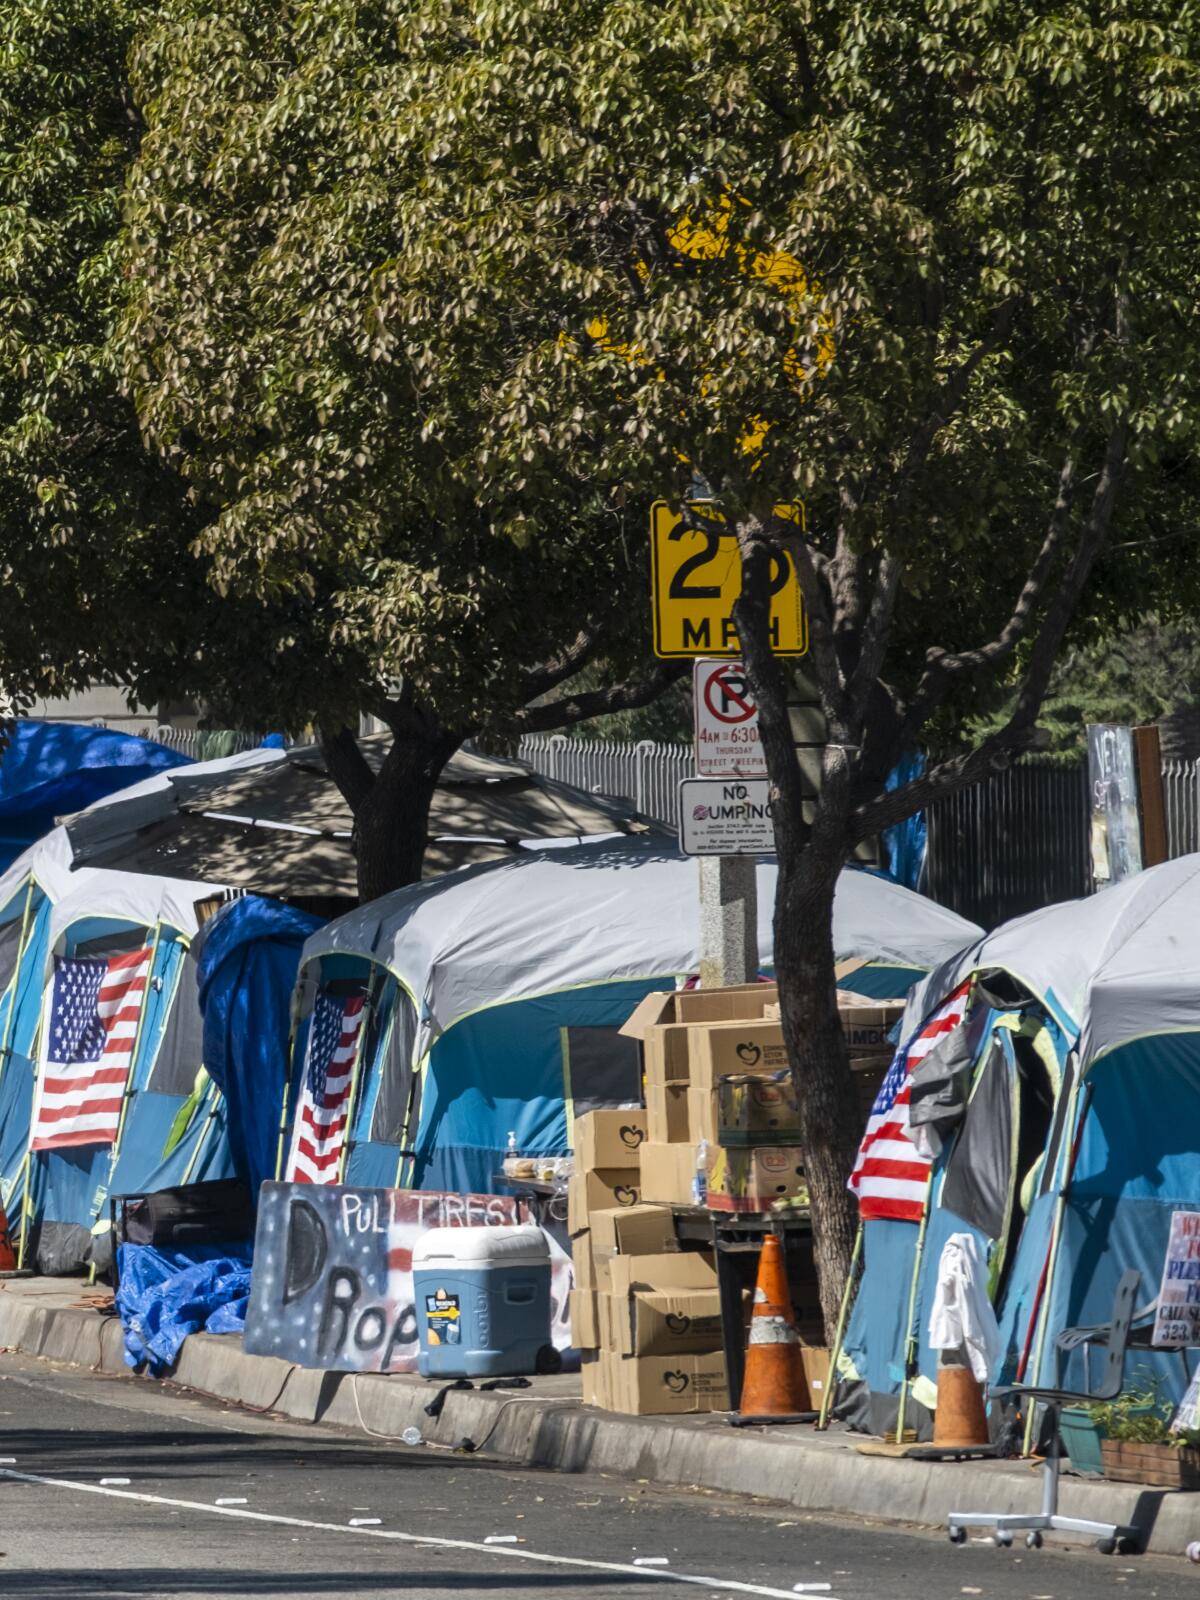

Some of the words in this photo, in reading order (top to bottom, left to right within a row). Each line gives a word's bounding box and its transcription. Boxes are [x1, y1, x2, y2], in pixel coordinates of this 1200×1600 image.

[700, 728, 719, 743] 4AM
[731, 757, 767, 767] WEEPIN
[724, 786, 748, 800] NO
[693, 803, 773, 820] UMPIN
